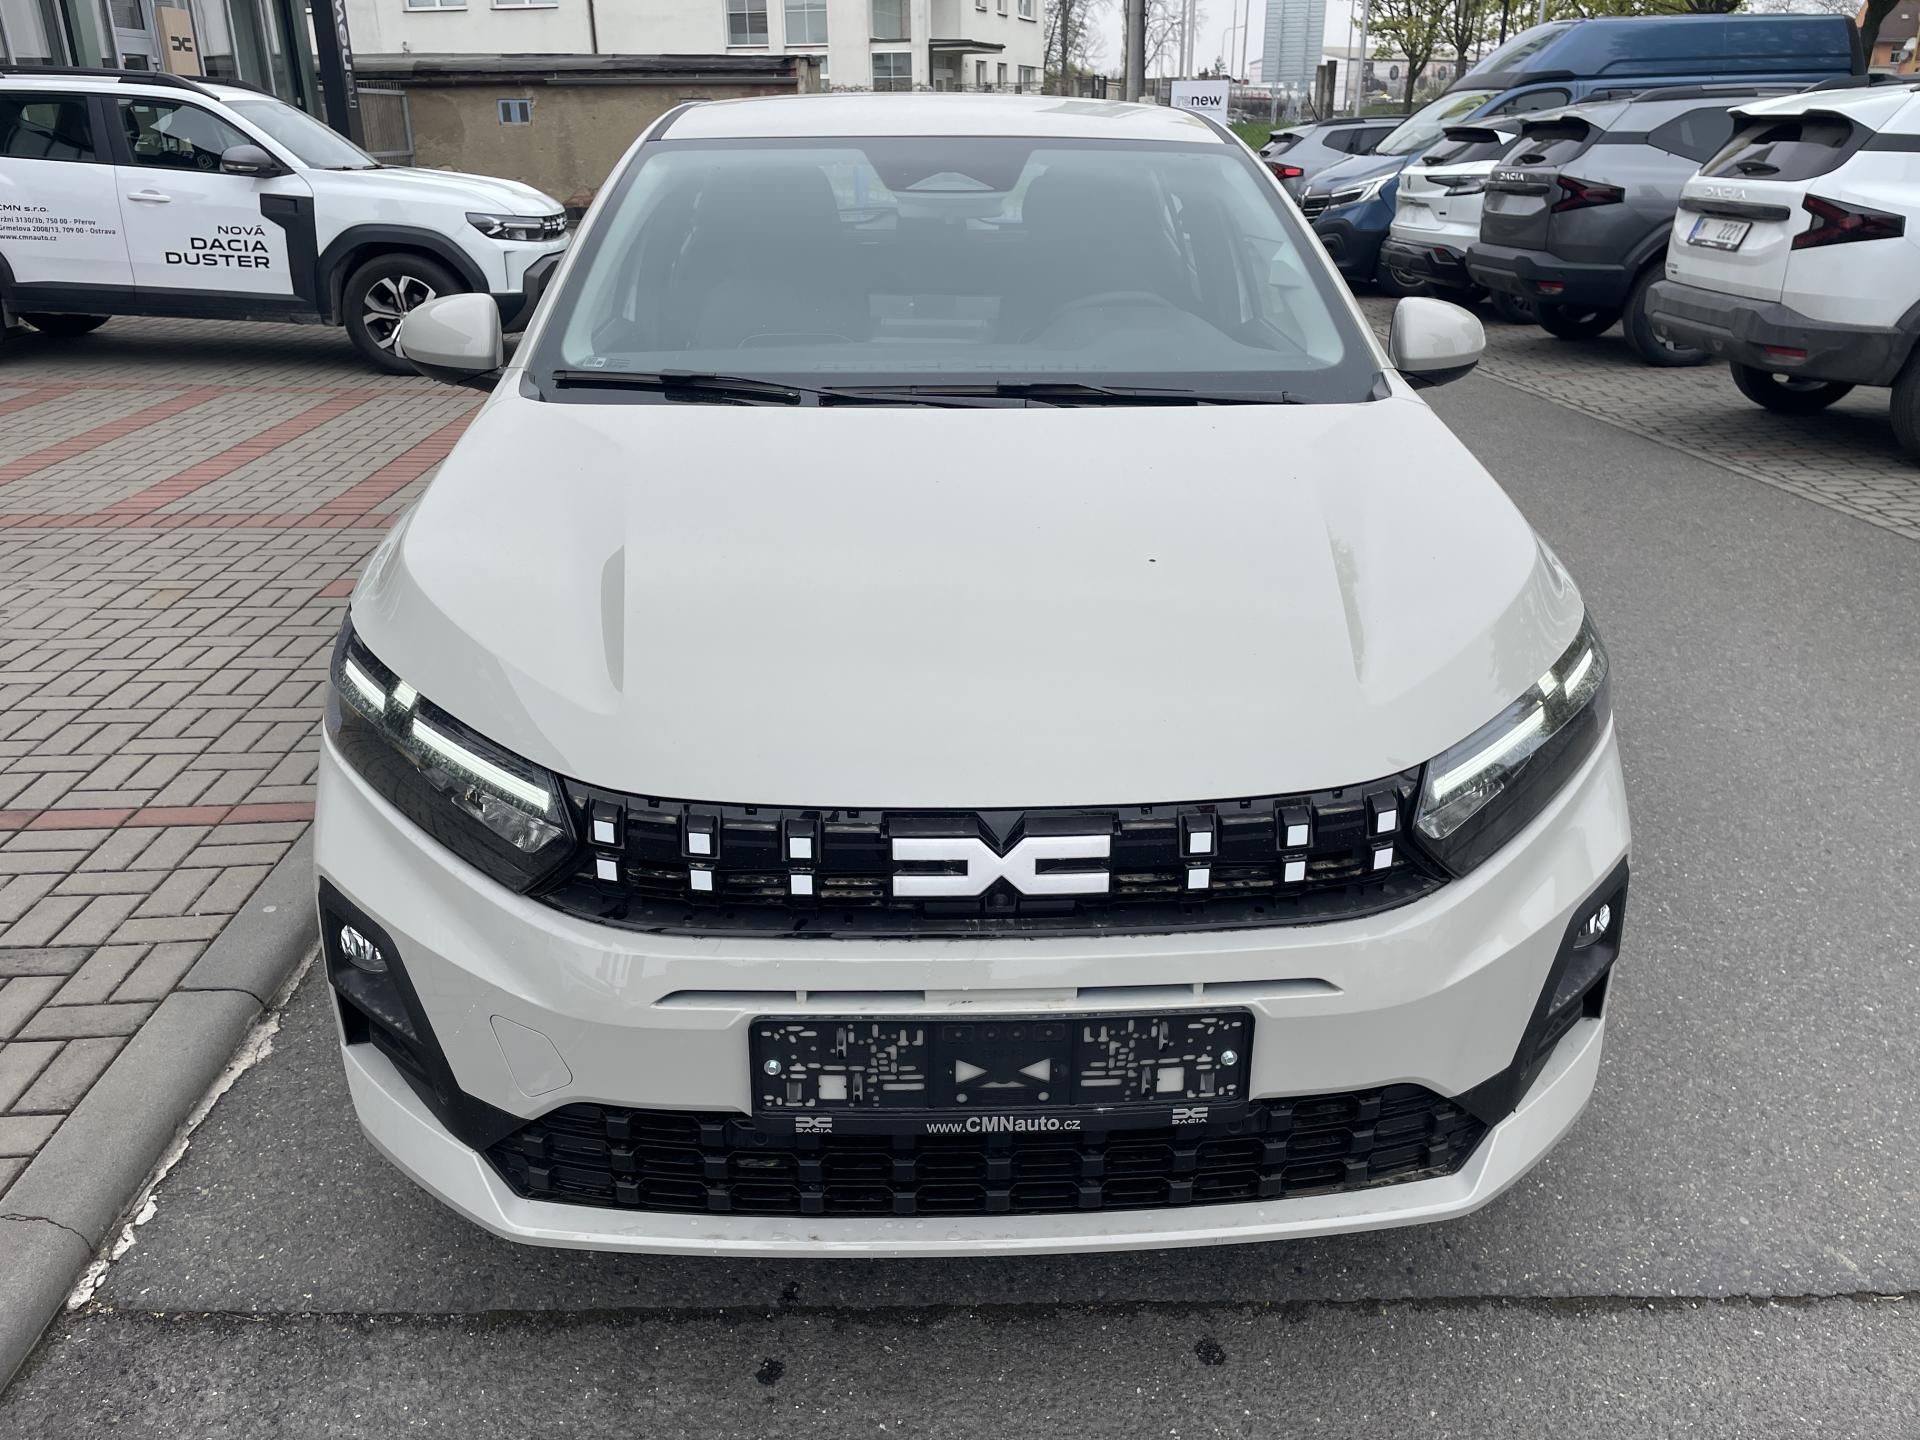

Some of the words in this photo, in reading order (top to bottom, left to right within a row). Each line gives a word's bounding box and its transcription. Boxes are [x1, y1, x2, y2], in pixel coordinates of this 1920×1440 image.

[1176, 95, 1222, 106] renew
[217, 225, 266, 236] NOVÁ
[190, 237, 269, 253] DACIA
[165, 252, 270, 268] DUSTER
[926, 1116, 1081, 1133] www.CMNauto.cz
